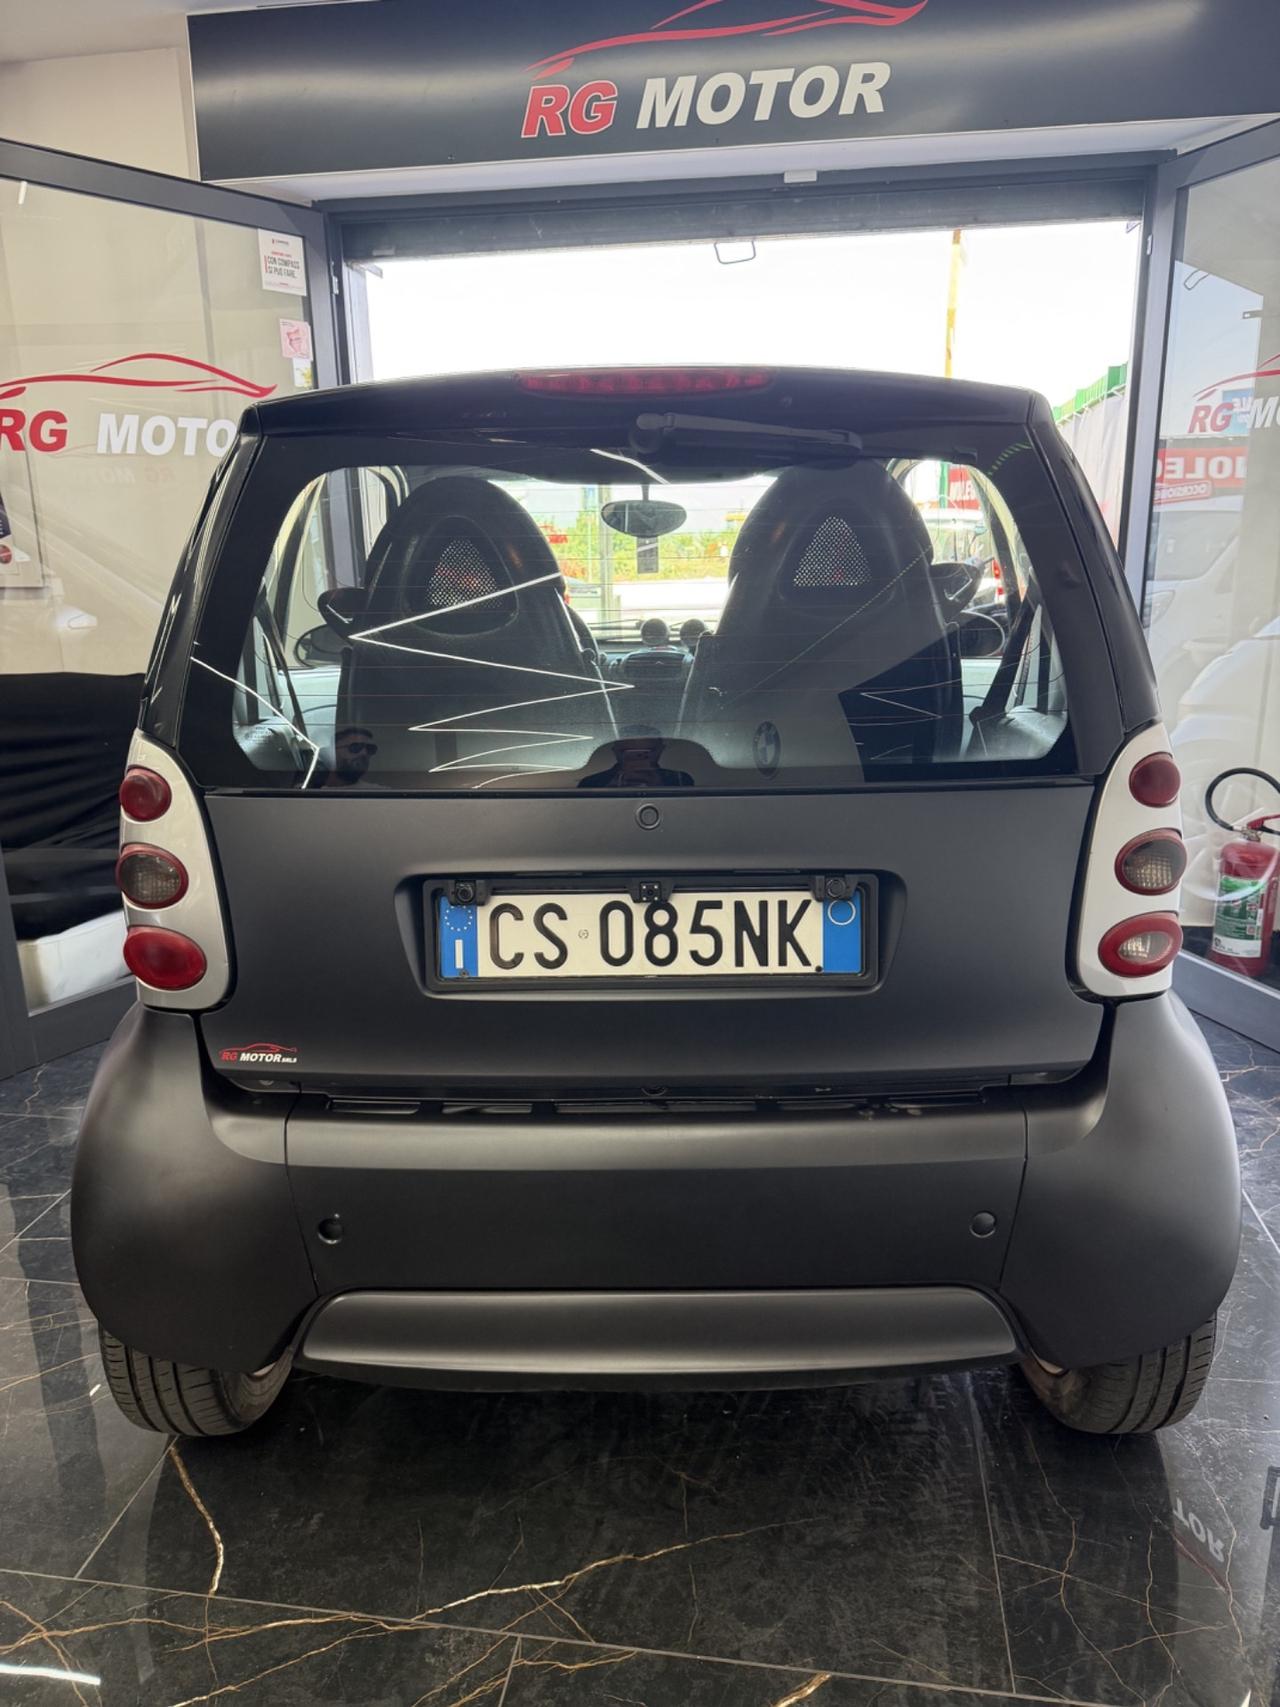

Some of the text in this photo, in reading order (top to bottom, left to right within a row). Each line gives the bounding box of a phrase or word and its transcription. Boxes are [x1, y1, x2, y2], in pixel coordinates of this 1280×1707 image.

[521, 61, 891, 138] RG MOTOR
[0, 409, 237, 457] RG MOTO
[1188, 402, 1234, 433] RG
[1248, 395, 1280, 428] M
[489, 902, 568, 970] CS
[600, 899, 813, 968] 085NK
[222, 1051, 238, 1062] RG
[240, 1052, 282, 1063] MOTOR
